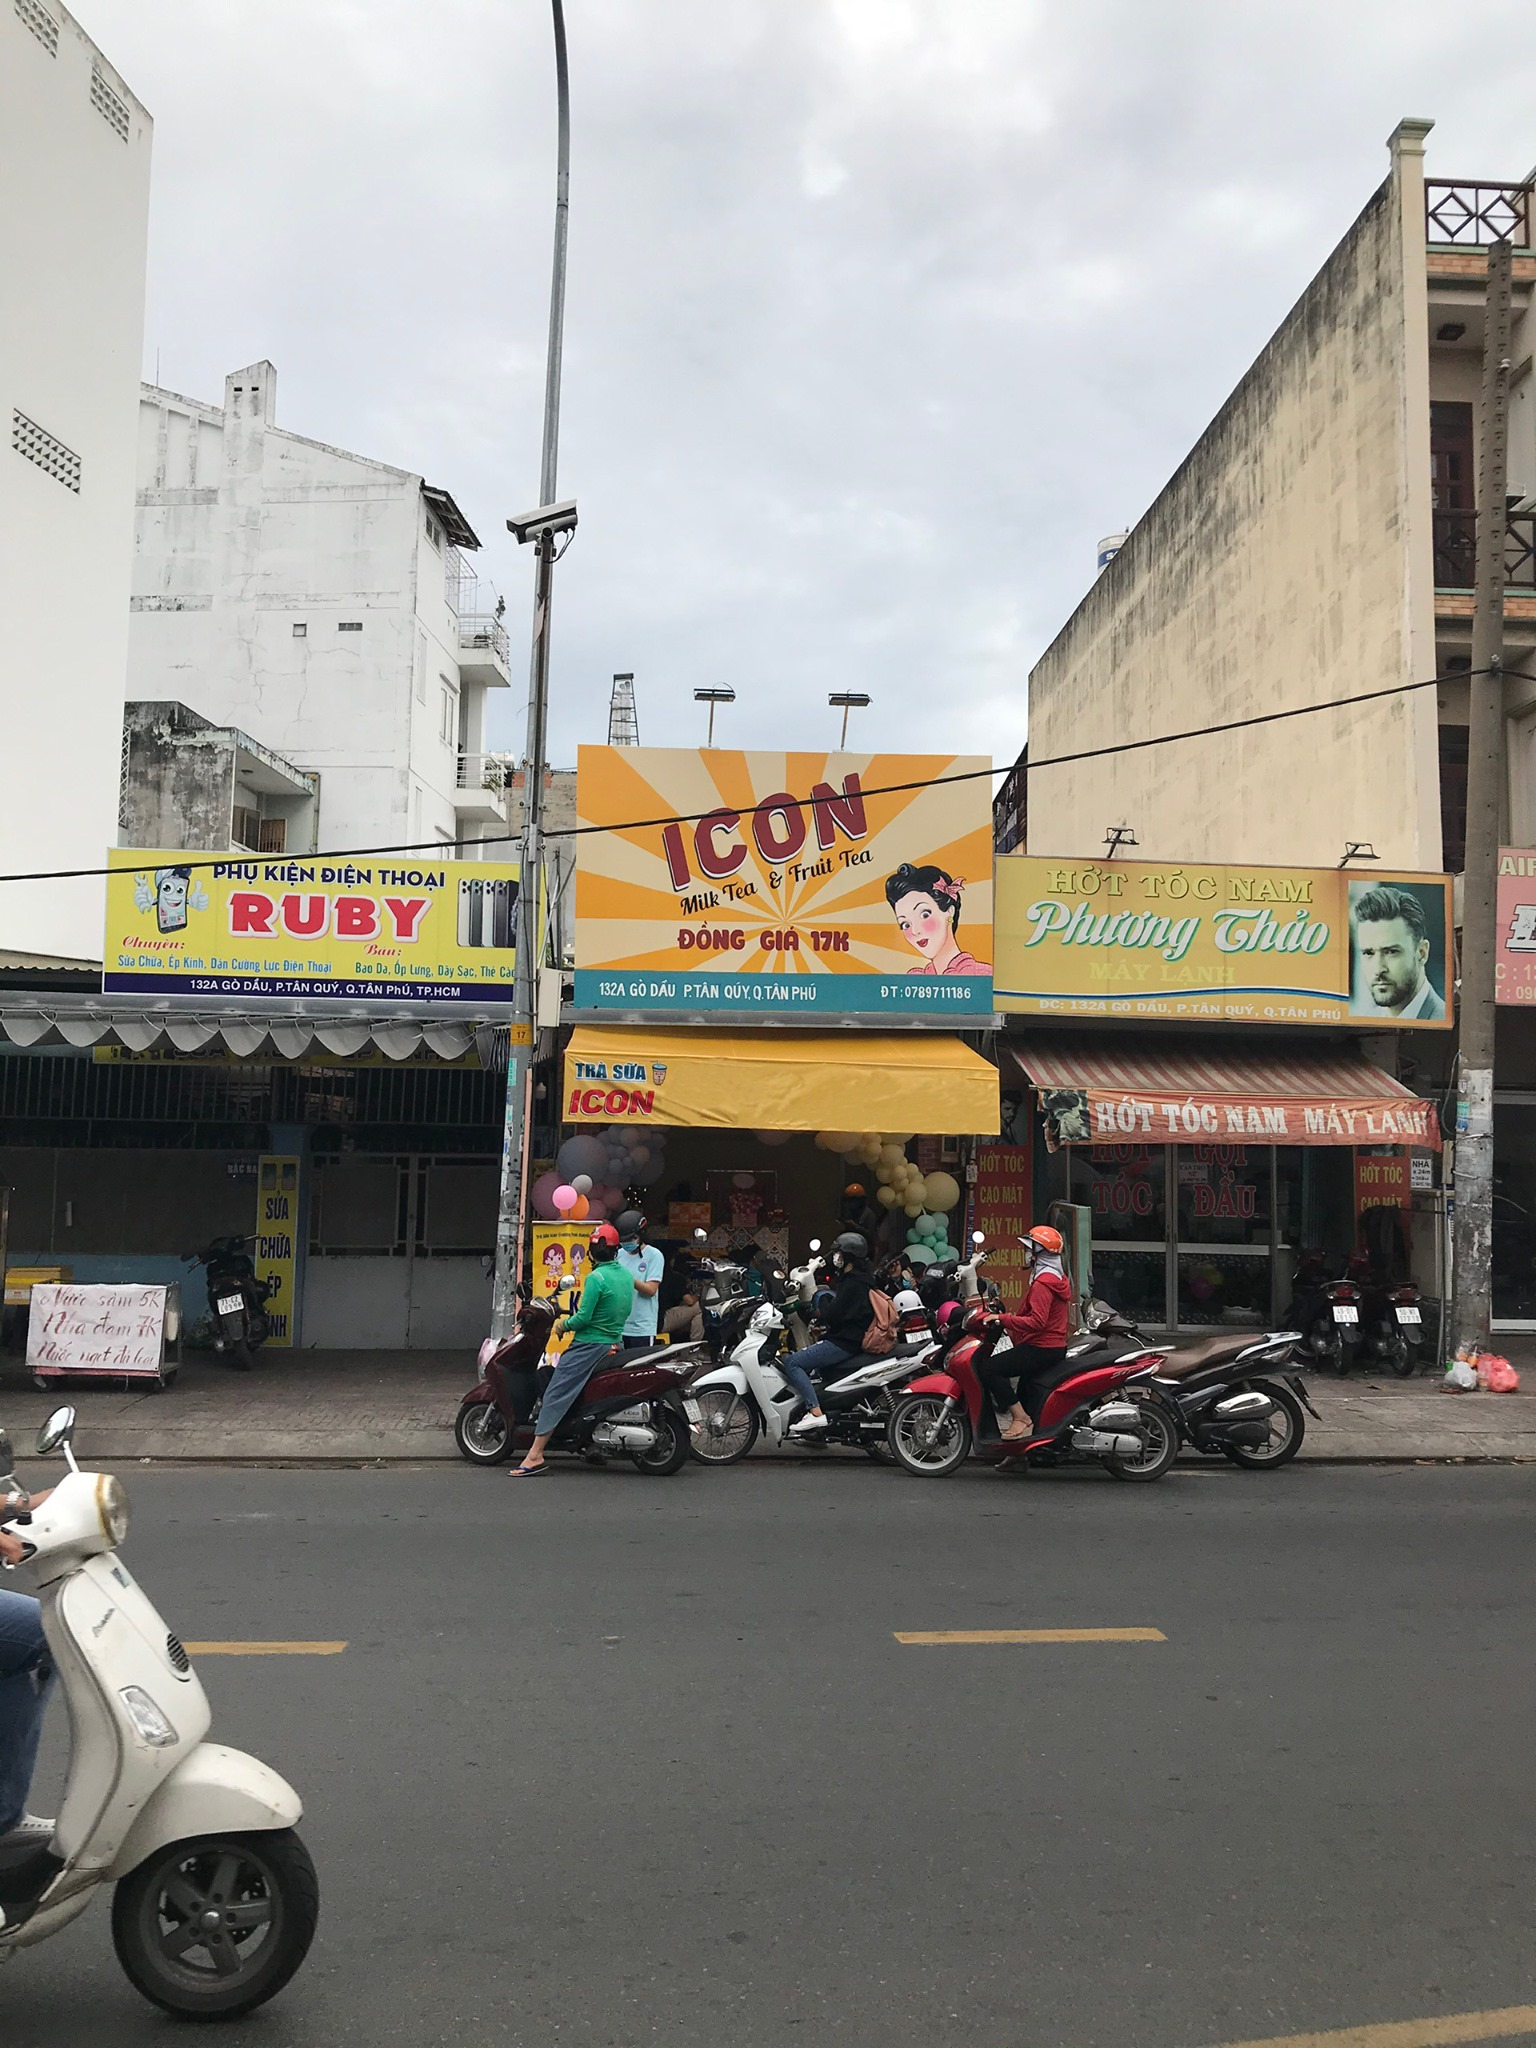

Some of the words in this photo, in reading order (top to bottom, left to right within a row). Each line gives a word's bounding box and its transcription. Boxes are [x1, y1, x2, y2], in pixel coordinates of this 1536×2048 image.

[662, 772, 869, 892] ICON
[213, 864, 258, 885] PHỤ
[264, 861, 315, 887] KIỆN
[321, 863, 372, 889] ĐIỆN
[378, 869, 445, 891] THOẠI
[680, 891, 720, 916] Milk
[722, 882, 758, 902] Tea
[769, 871, 783, 889] &
[788, 858, 835, 883] Fruit
[839, 848, 874, 868] Tea
[1047, 867, 1129, 897] HỚT
[1139, 869, 1218, 901] TÓC
[1229, 878, 1313, 903] NAM
[228, 892, 430, 941] RUBY
[677, 921, 745, 950] ĐỒNG
[760, 926, 799, 951] GIÁ
[811, 931, 850, 951] 17K
[1024, 900, 1201, 962] Phương
[1212, 908, 1331, 955] Thảo
[355, 962, 373, 974] Bao
[1089, 960, 1152, 981] MÁY
[1160, 964, 1235, 986] LẠNH
[190, 979, 219, 990] 132A
[221, 978, 241, 991] GÒ
[275, 980, 310, 993] P.TÂN
[346, 982, 383, 995] Q.TÂN
[417, 986, 461, 997] TP.HCM
[599, 982, 626, 996] 132A
[629, 979, 647, 997] GÒ
[792, 983, 817, 1000] PHÚ
[1070, 1000, 1107, 1011] 132A
[1111, 1000, 1132, 1012] GÒ
[1312, 1008, 1341, 1020] PHÚ
[516, 1031, 526, 1039] 17
[575, 1062, 608, 1079] TRÀ
[612, 1062, 647, 1081] SỮA
[569, 1089, 655, 1116] ICON
[1095, 1095, 1154, 1133] HỚT
[1161, 1097, 1218, 1134] TÓC
[1224, 1106, 1288, 1134] NAM
[1304, 1103, 1358, 1135] MÁY
[1366, 1109, 1429, 1139] LẠNH
[1003, 1151, 1024, 1173] TÓC
[1382, 1162, 1403, 1184] TÓC
[265, 1191, 289, 1220] SỬA
[1092, 1171, 1152, 1216] TÓC
[1193, 1170, 1256, 1218] ĐẦU
[1005, 1217, 1023, 1235] TAI
[260, 1232, 291, 1259] CHỮA
[139, 1290, 161, 1308] 5K
[136, 1315, 162, 1338] 7K
